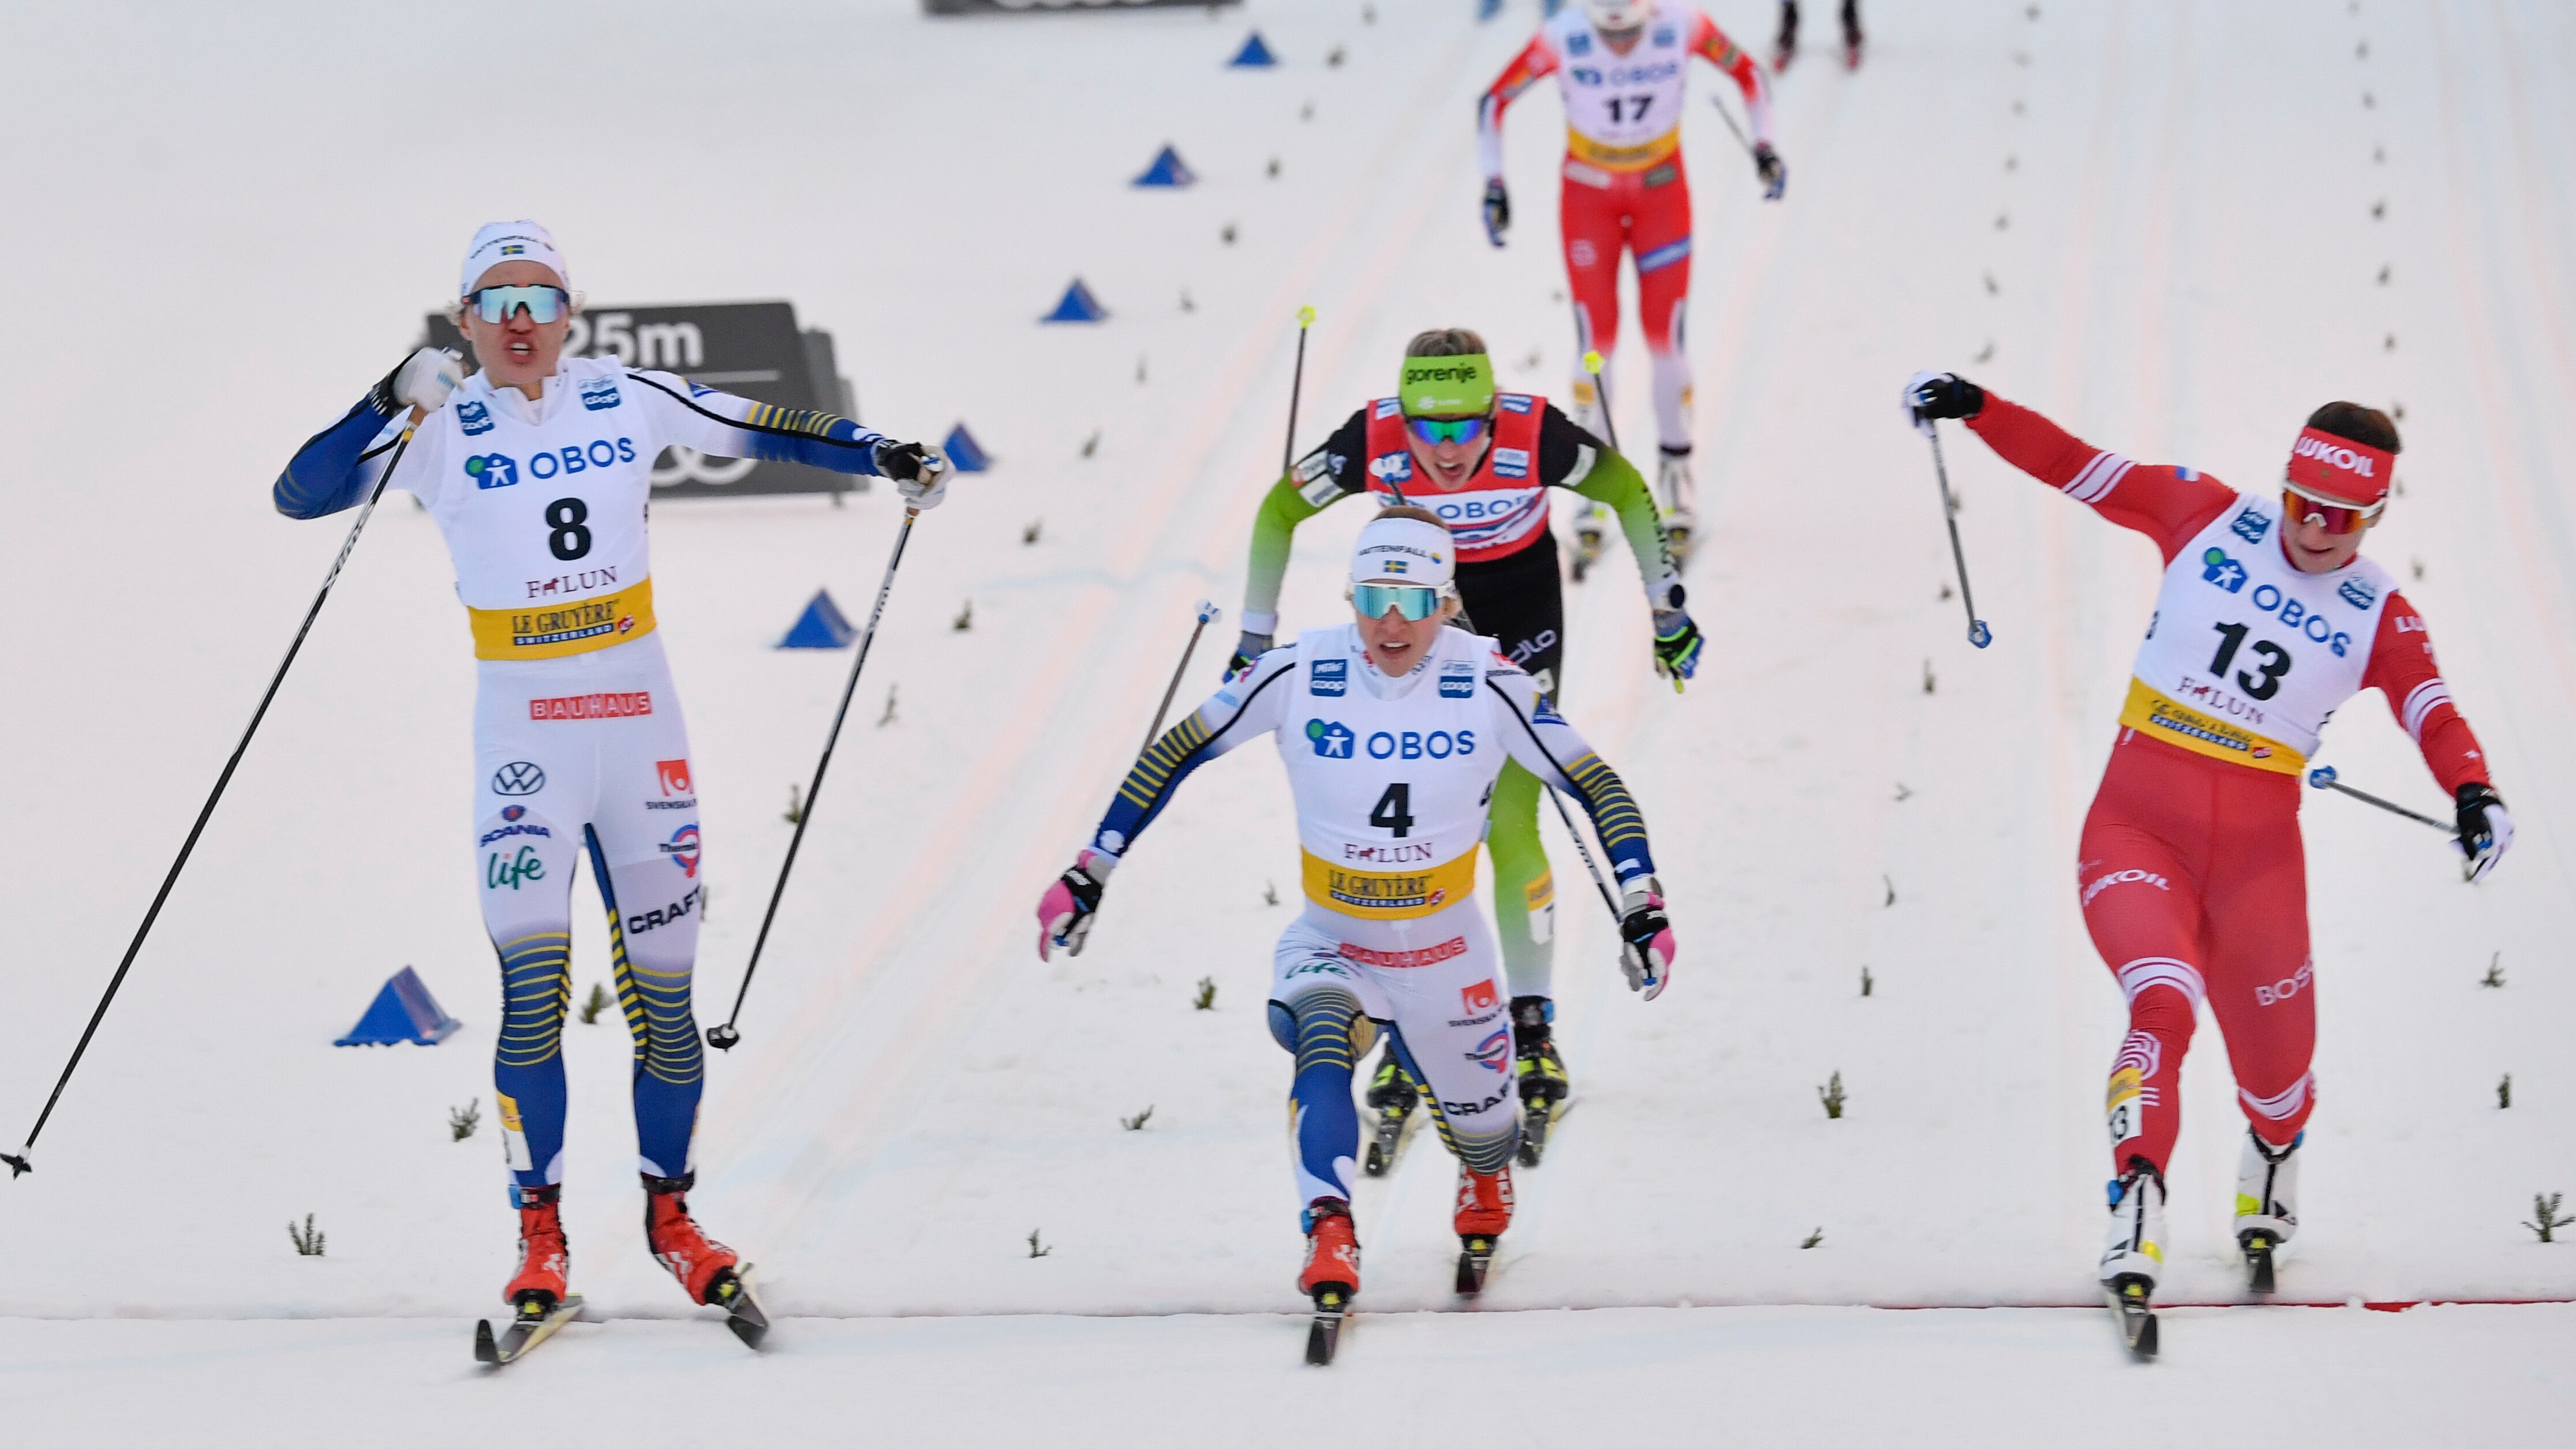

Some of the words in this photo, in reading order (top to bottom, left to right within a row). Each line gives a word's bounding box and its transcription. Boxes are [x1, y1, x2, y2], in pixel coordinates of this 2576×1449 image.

[1604, 95, 1653, 123] 17
[1405, 361, 1476, 385] gorenje
[530, 437, 637, 479] OBOS
[2294, 436, 2375, 477] LUKOIL
[545, 497, 592, 561] 8
[512, 615, 532, 634] LE
[515, 624, 613, 645] SWITZERLAND
[2253, 584, 2351, 658] OBOS
[2208, 621, 2292, 701] 13
[532, 694, 650, 718] BAUHAUS
[1367, 730, 1476, 759] OBOS
[1369, 782, 1415, 838] 4
[480, 824, 551, 847] SCANIA
[488, 845, 547, 890] life
[1340, 937, 1467, 967] BAUHAUS
